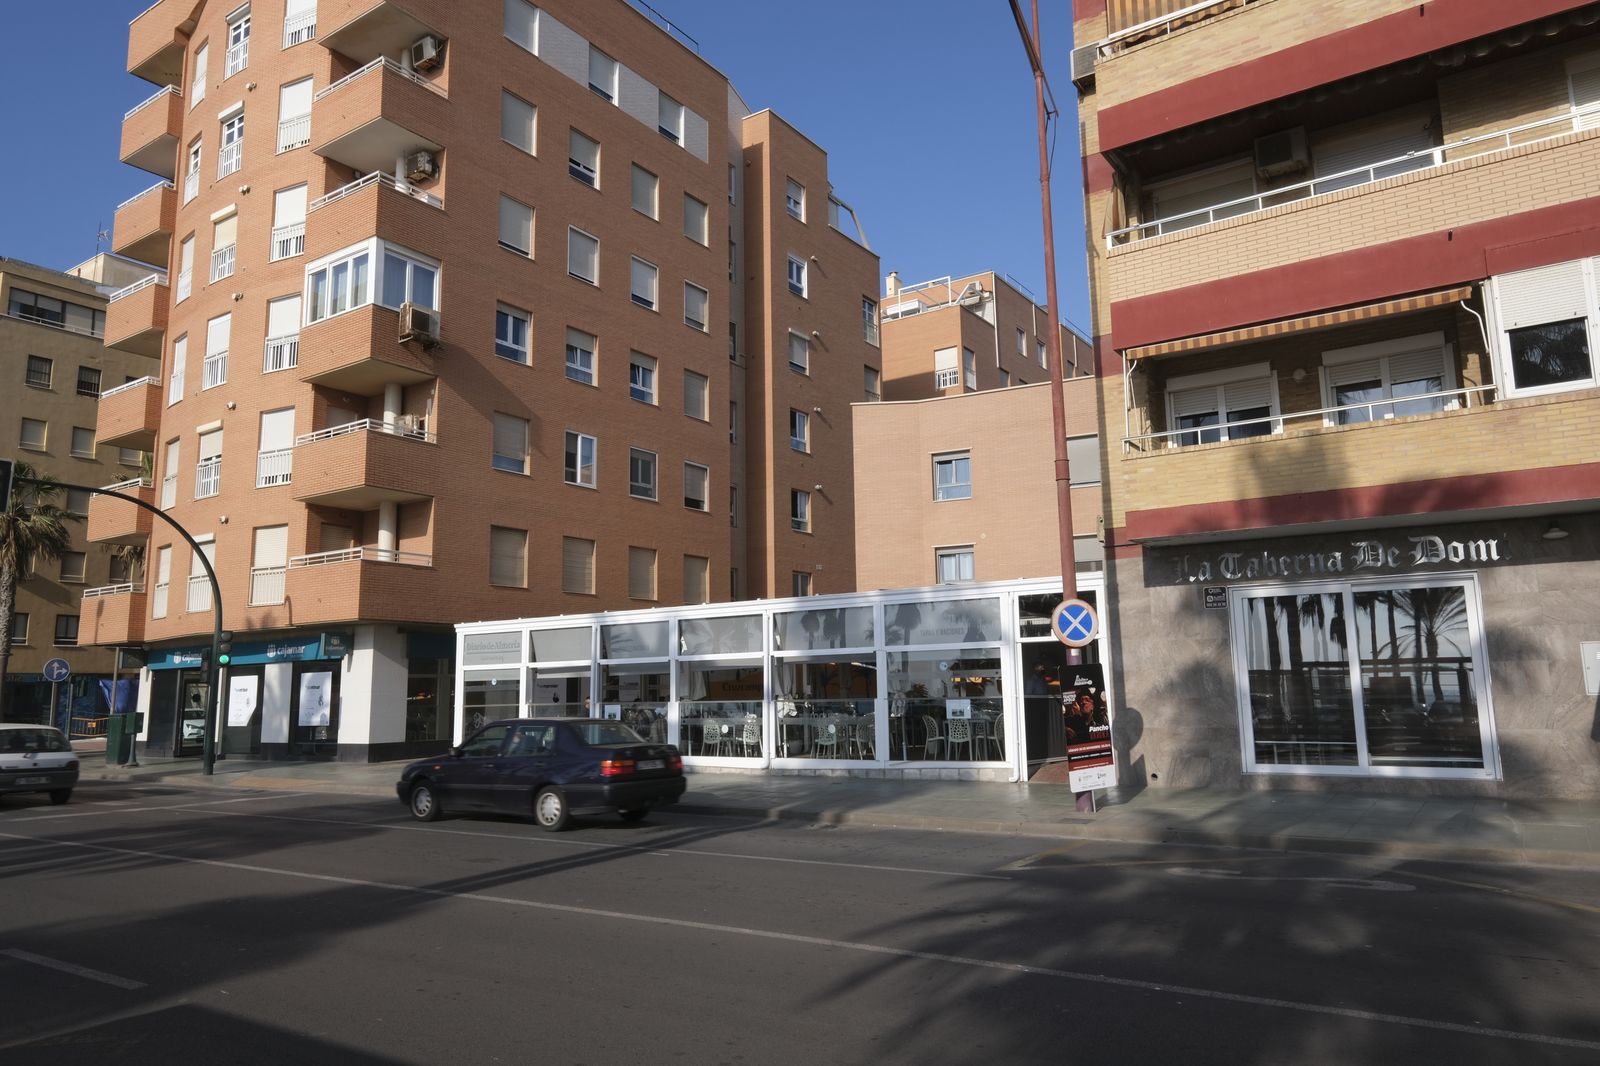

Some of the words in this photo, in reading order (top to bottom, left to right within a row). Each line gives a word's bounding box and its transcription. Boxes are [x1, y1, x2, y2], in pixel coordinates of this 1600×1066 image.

[1174, 554, 1213, 583] La
[1218, 550, 1345, 580] Taberna
[1350, 540, 1400, 569] De
[277, 643, 306, 659] cajamar
[1089, 725, 1109, 733] Pancho
